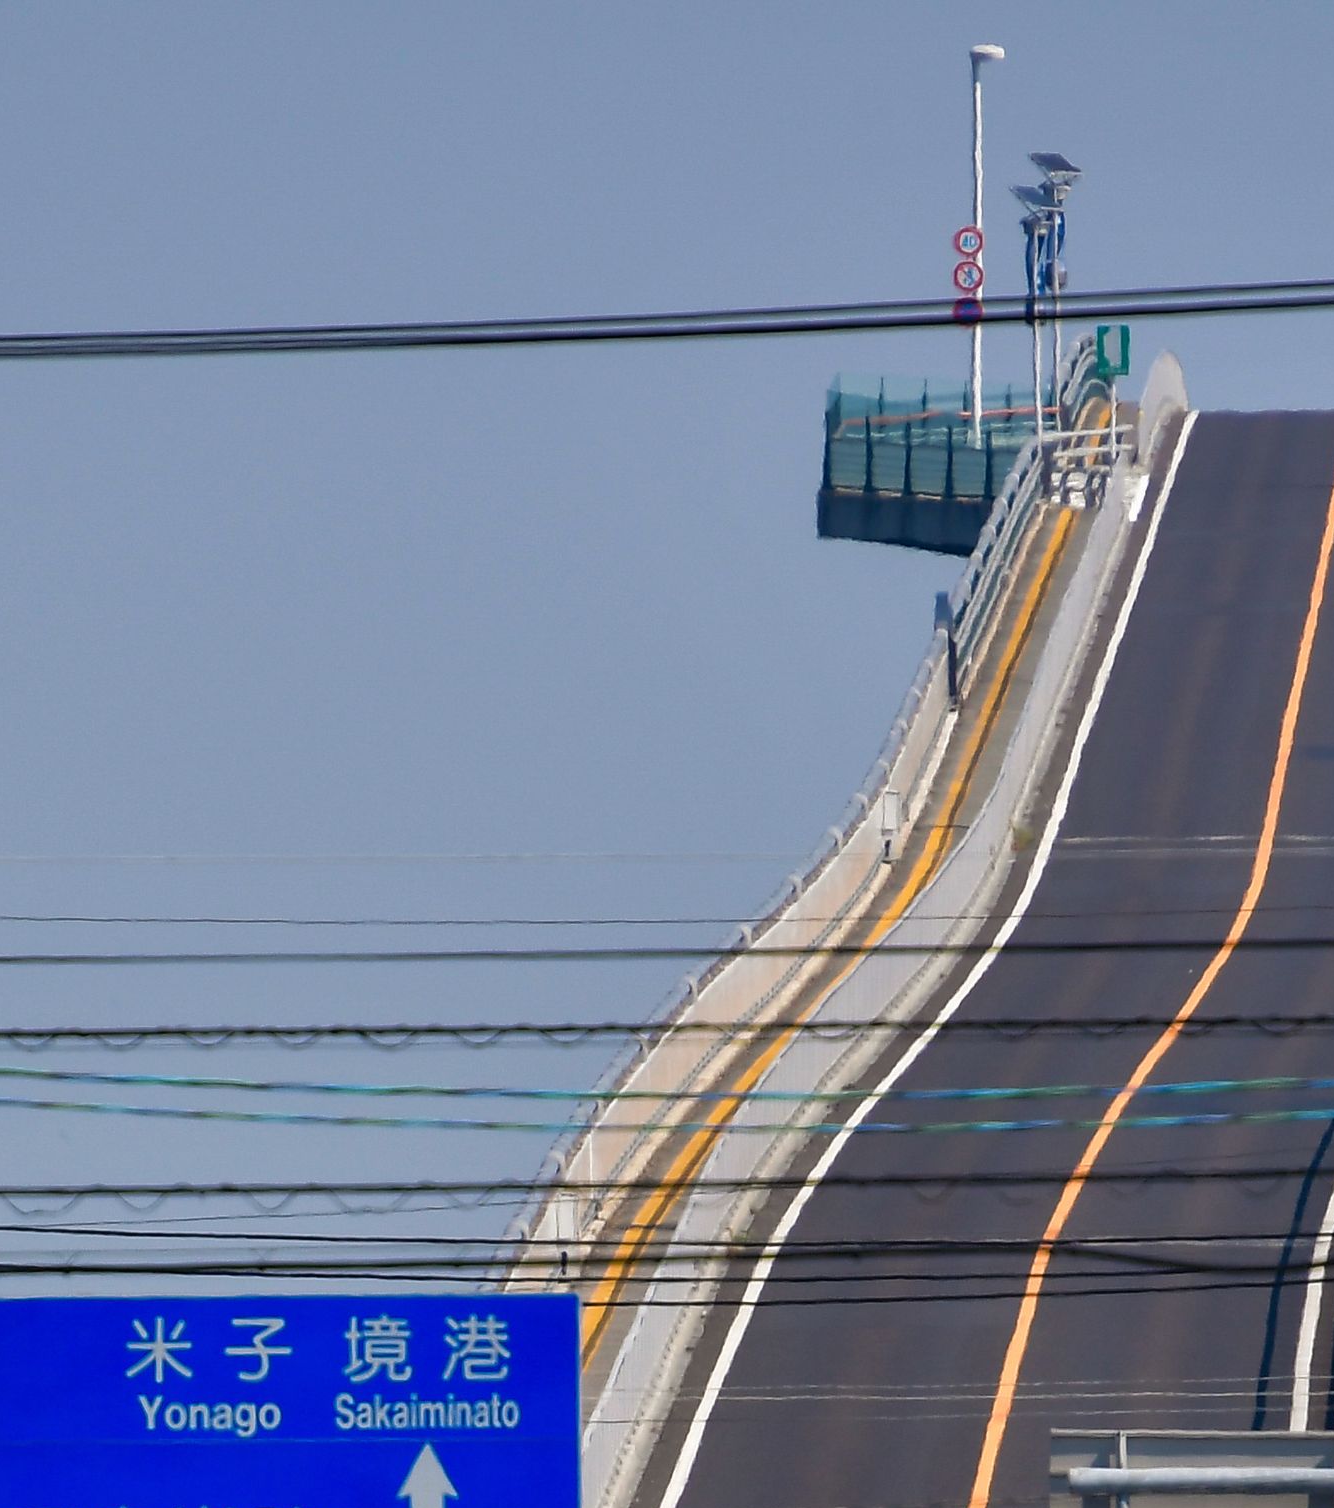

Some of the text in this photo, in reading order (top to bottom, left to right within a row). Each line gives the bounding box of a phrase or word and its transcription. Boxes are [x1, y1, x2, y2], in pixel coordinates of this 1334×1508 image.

[127, 1316, 511, 1383] 米子 境港
[140, 1394, 520, 1437] Yonago Sakaiminato
